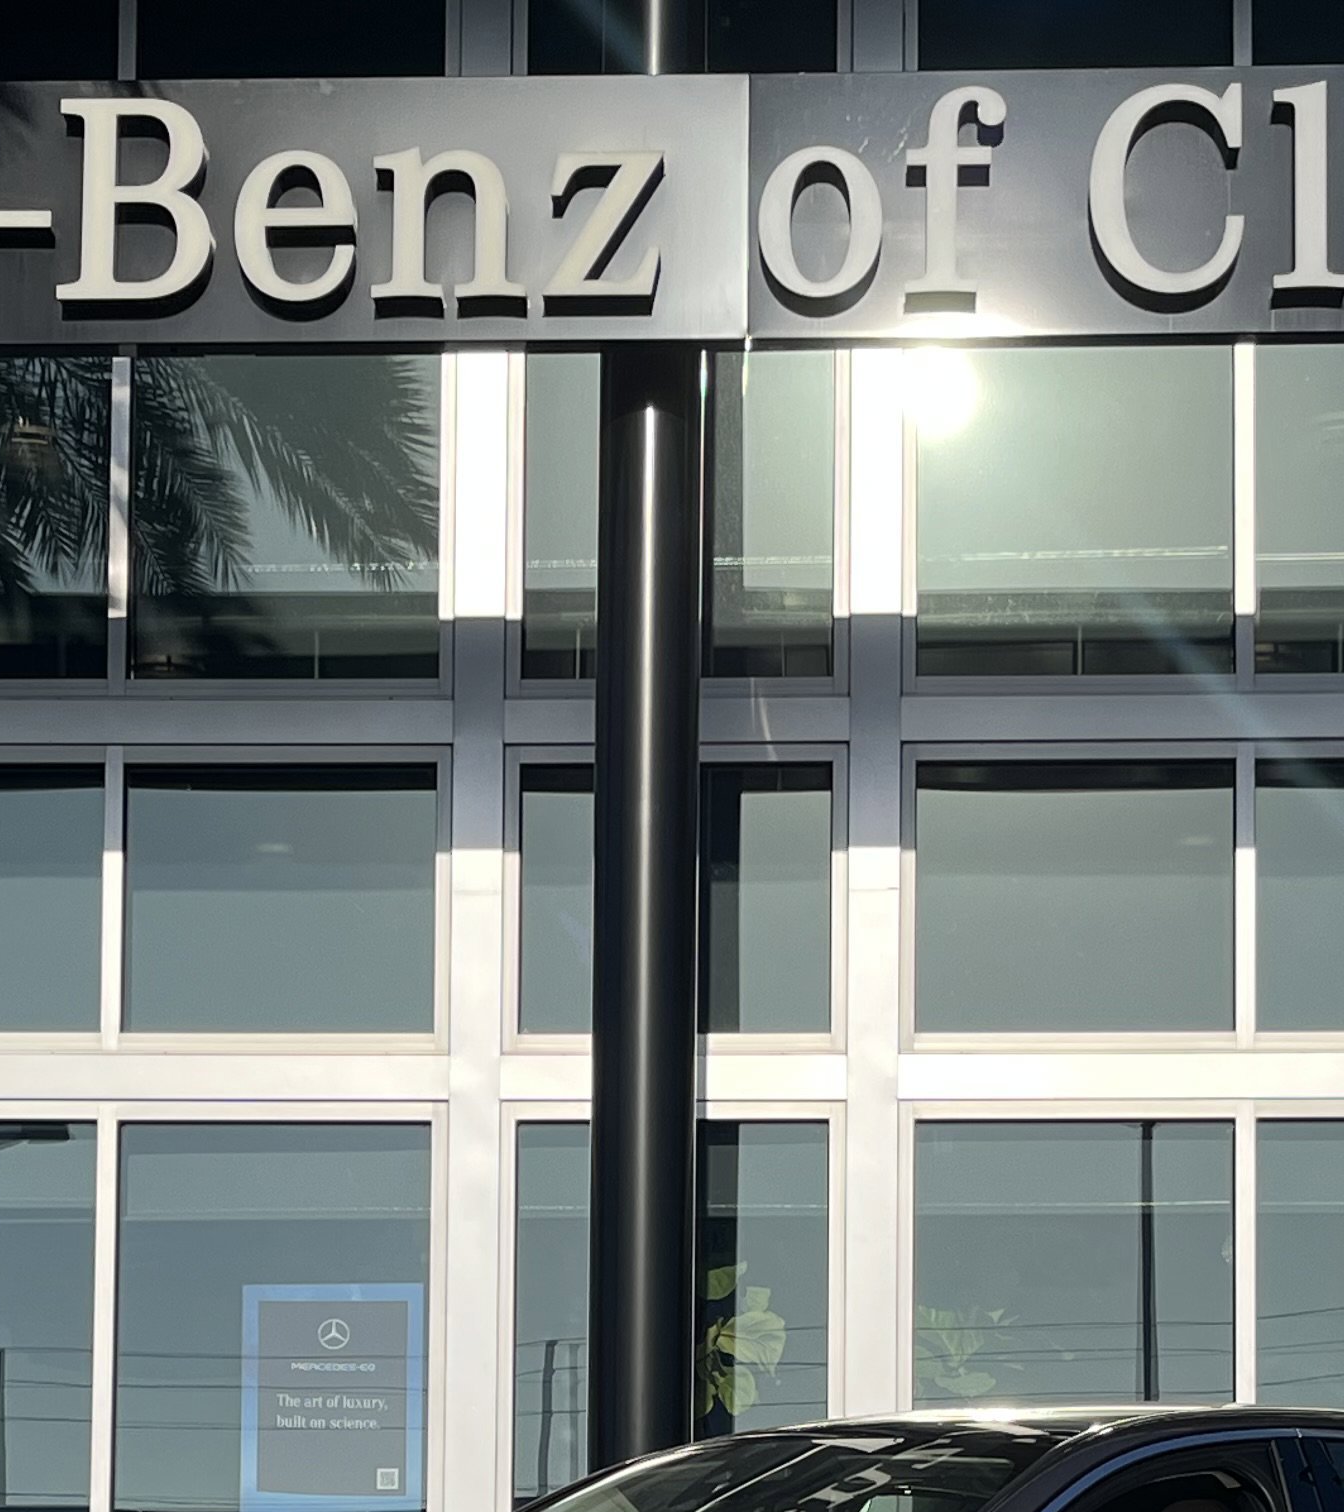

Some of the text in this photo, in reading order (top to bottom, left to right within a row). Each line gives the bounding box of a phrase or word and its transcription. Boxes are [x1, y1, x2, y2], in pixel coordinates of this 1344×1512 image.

[754, 84, 1006, 310] of
[276, 1393, 388, 1412] The art of luxury,
[276, 1414, 381, 1430] built on science.
